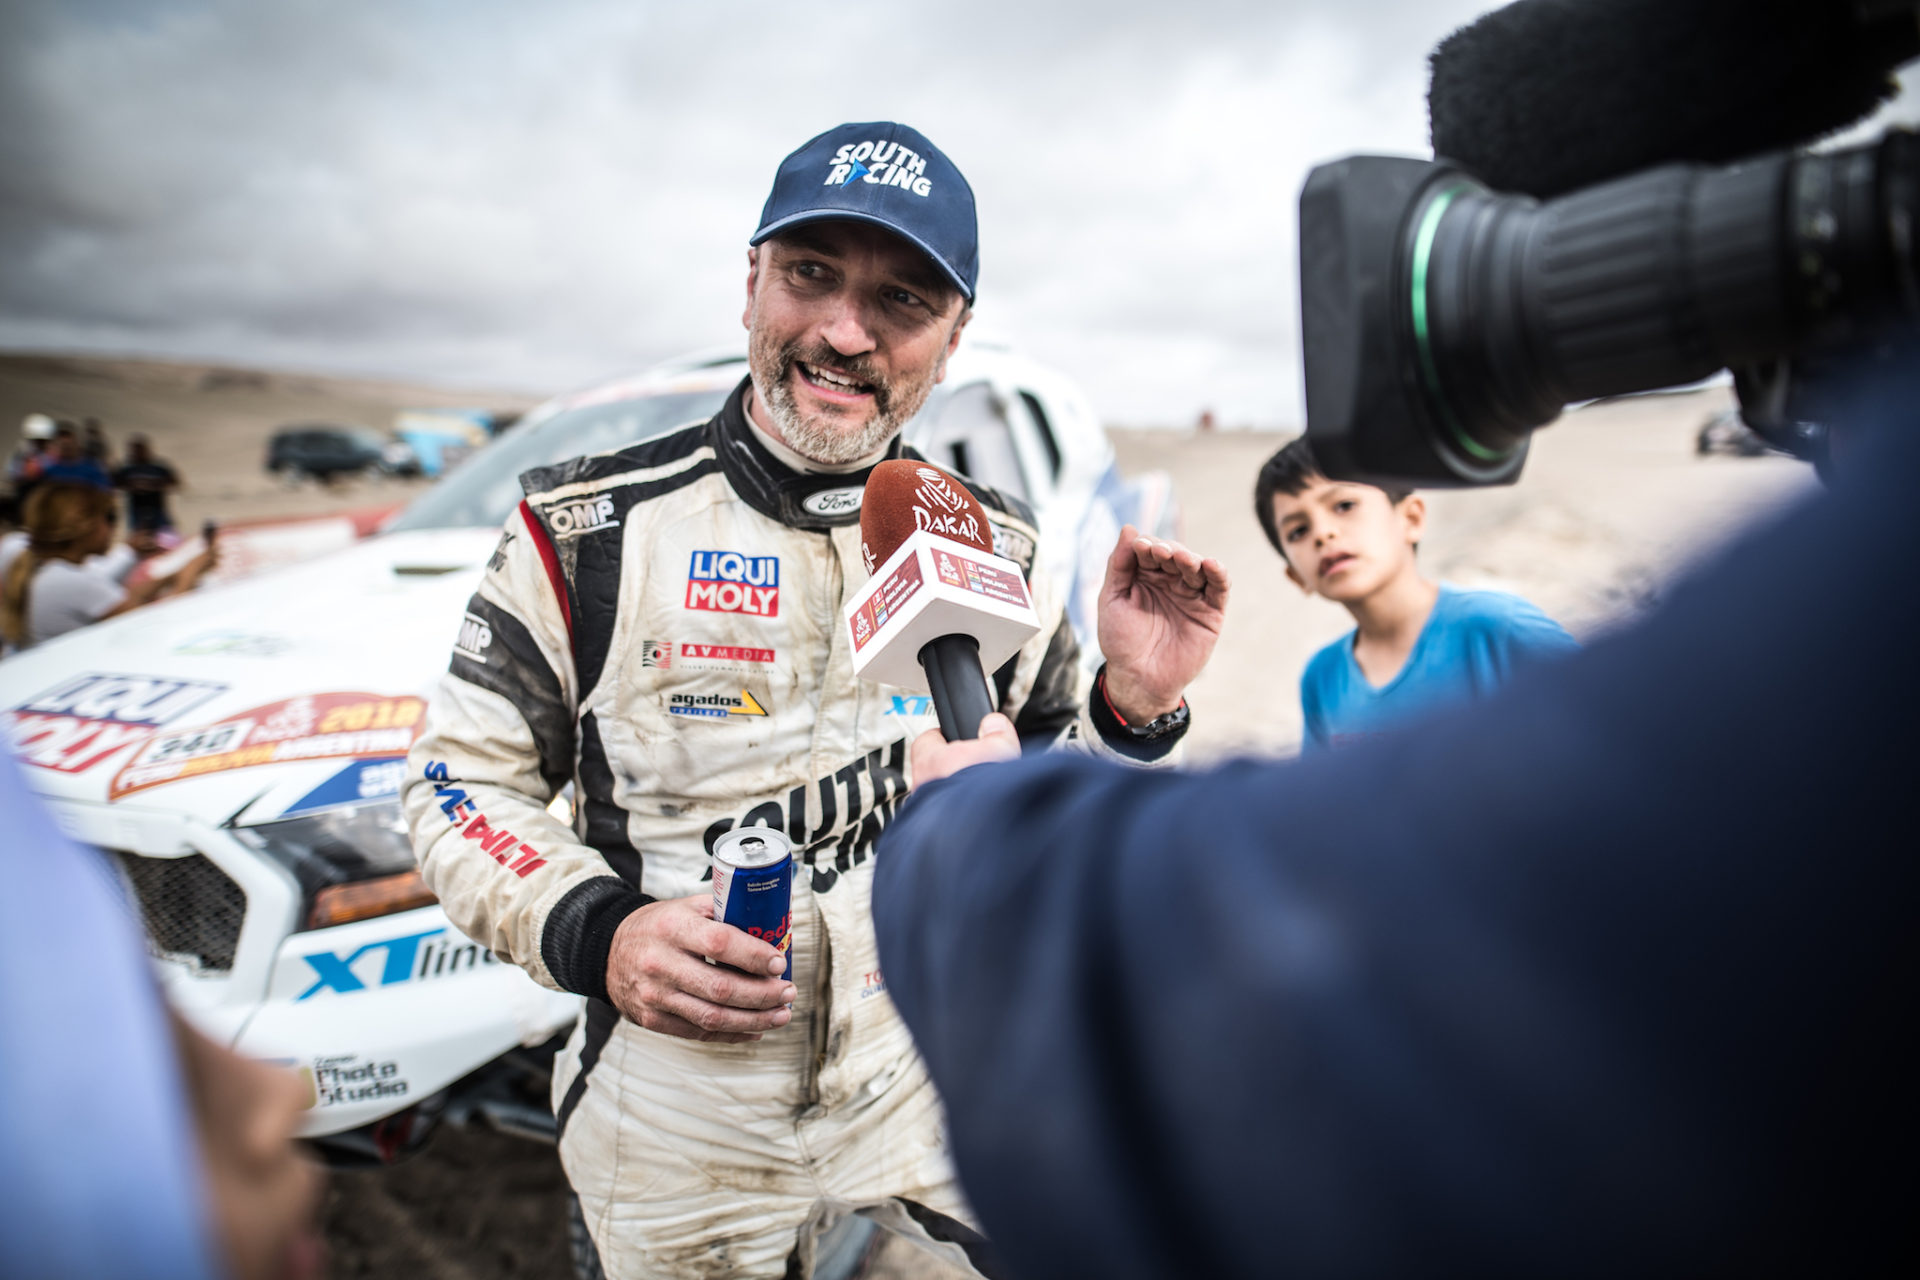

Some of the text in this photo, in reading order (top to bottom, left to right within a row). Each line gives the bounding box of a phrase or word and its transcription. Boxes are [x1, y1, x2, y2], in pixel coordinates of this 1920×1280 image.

[829, 140, 927, 176] SOUTH
[550, 499, 615, 533] OMP
[818, 491, 860, 511] Ford
[912, 505, 985, 545] DAKAR
[693, 552, 775, 586] LIQUI
[689, 582, 777, 615] MOLY
[457, 620, 492, 654] MP
[671, 694, 742, 707] agados
[317, 1062, 397, 1086] Photo
[320, 1081, 408, 1106] Studio
